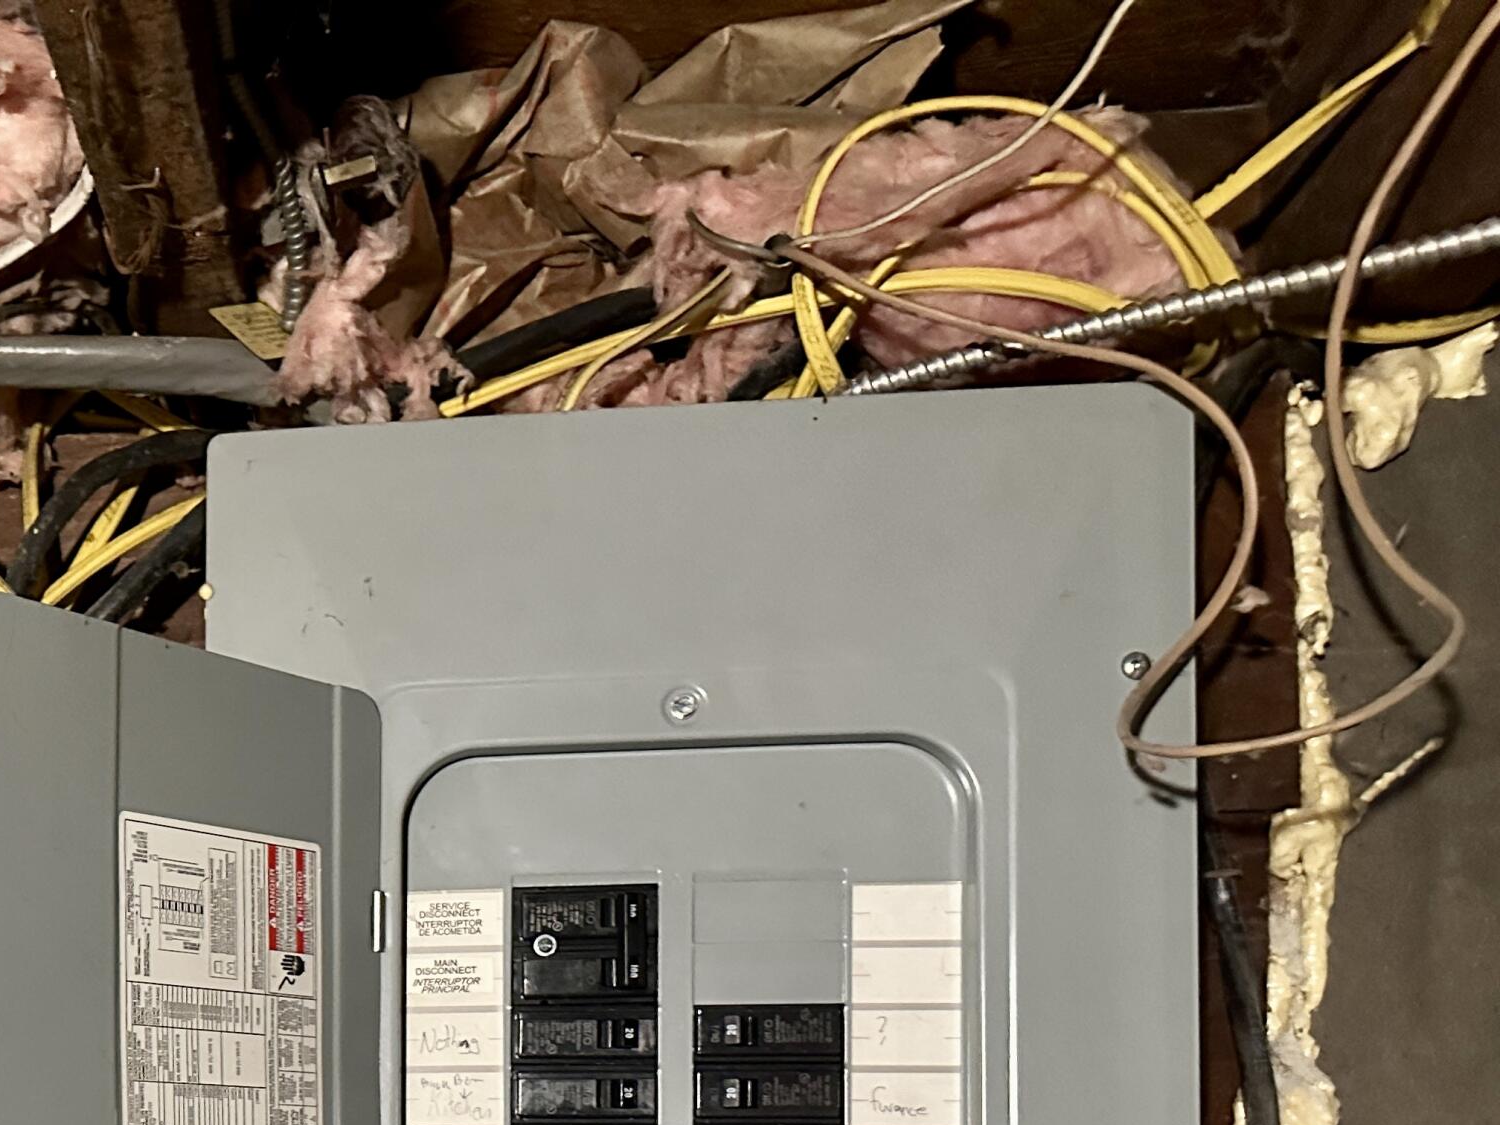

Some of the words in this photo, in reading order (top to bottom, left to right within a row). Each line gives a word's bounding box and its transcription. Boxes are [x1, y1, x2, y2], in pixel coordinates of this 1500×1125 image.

[429, 902, 471, 911] SERVICE
[419, 908, 481, 918] DISCONNECT
[416, 919, 483, 929] INTERRUPTOR
[419, 928, 431, 936] DE
[432, 927, 482, 936] ACOMETIDA
[434, 959, 458, 967] MAIN
[415, 966, 477, 976] DISCONNECT
[412, 977, 481, 987] INTERRUPTOR
[421, 985, 471, 994] PRINCIPAL
[624, 1027, 635, 1039] 20
[725, 1024, 738, 1036] 20
[623, 1087, 634, 1099] 20
[725, 1087, 738, 1099] 20
